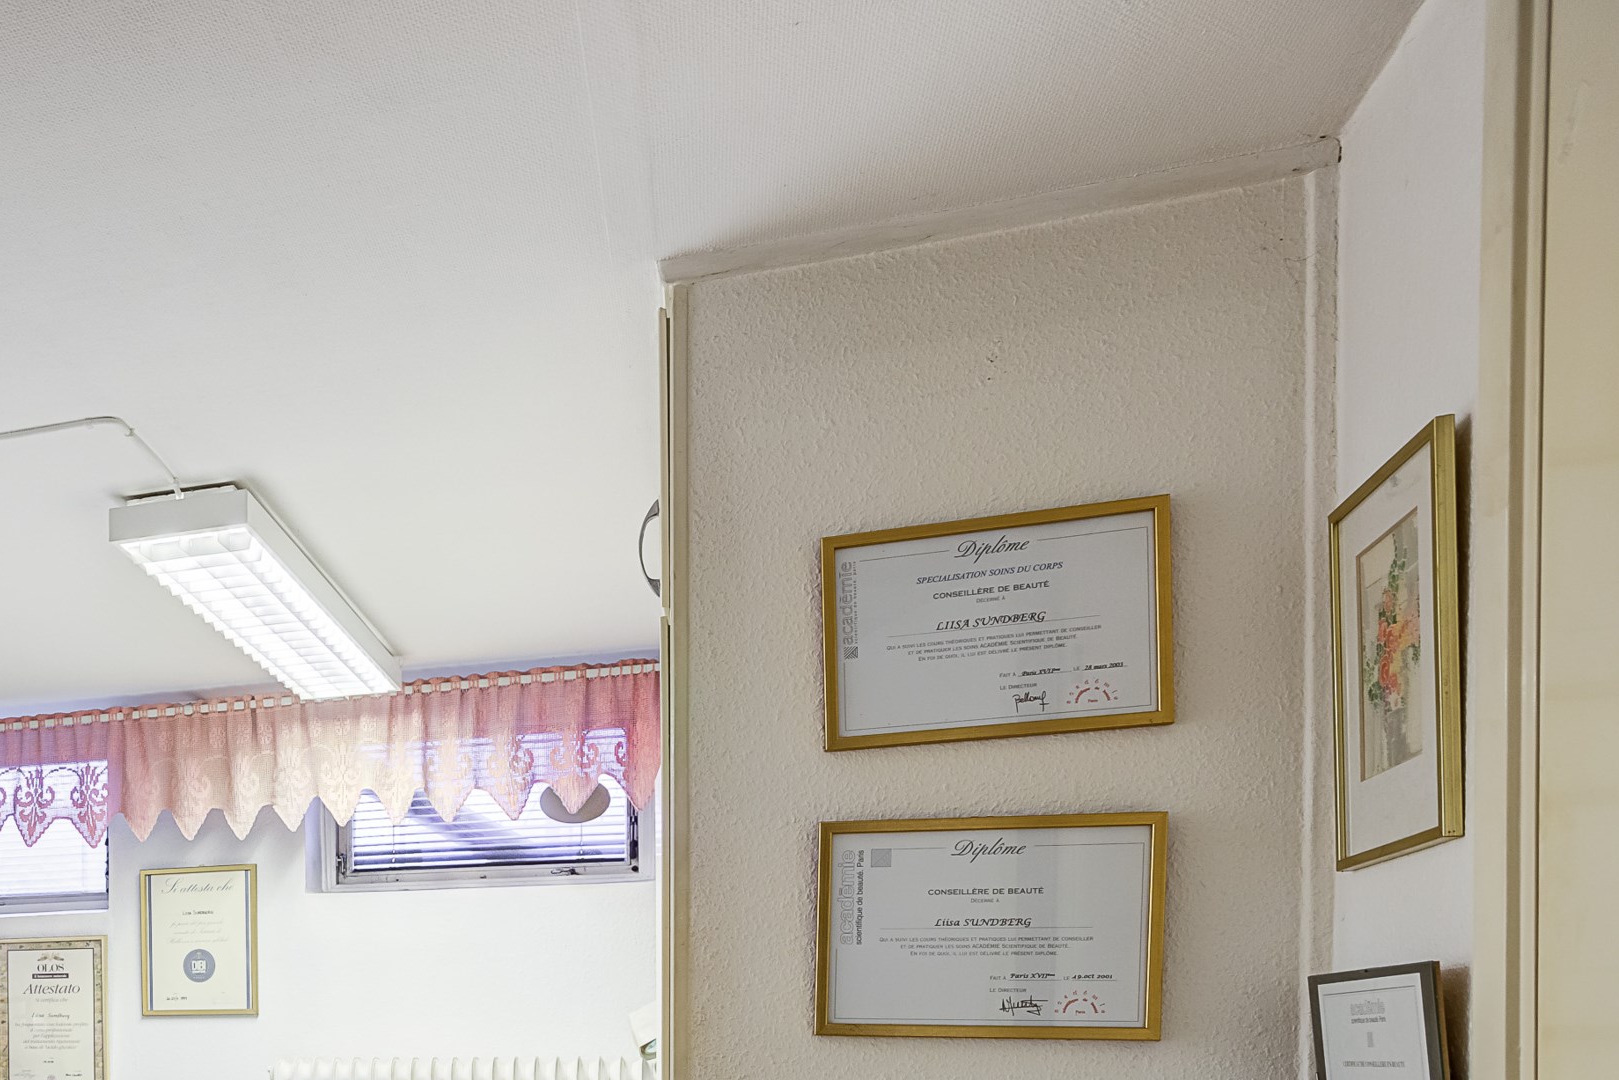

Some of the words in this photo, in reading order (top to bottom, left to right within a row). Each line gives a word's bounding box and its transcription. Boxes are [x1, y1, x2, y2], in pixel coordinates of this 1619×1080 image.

[954, 535, 1030, 564] Diplôme
[916, 571, 987, 585] SPECIALISATION
[989, 567, 1015, 577] SOINS
[1017, 565, 1031, 573] DU
[1033, 561, 1063, 572] CORPS
[997, 585, 1010, 593] DE
[1013, 581, 1050, 591] BEAUTÉ
[936, 620, 970, 631] LIISA
[972, 611, 1046, 627] SUNDBERG
[951, 837, 1027, 863] Diplôme
[855, 850, 865, 867] Paris
[1007, 886, 1044, 895] BEAUTÉ
[855, 897, 863, 906] de
[855, 907, 864, 945] scientifique
[934, 919, 960, 927] Liisa
[963, 918, 1032, 928] SUNDBERG
[37, 963, 65, 972] OLOS
[22, 983, 80, 995] Attestato
